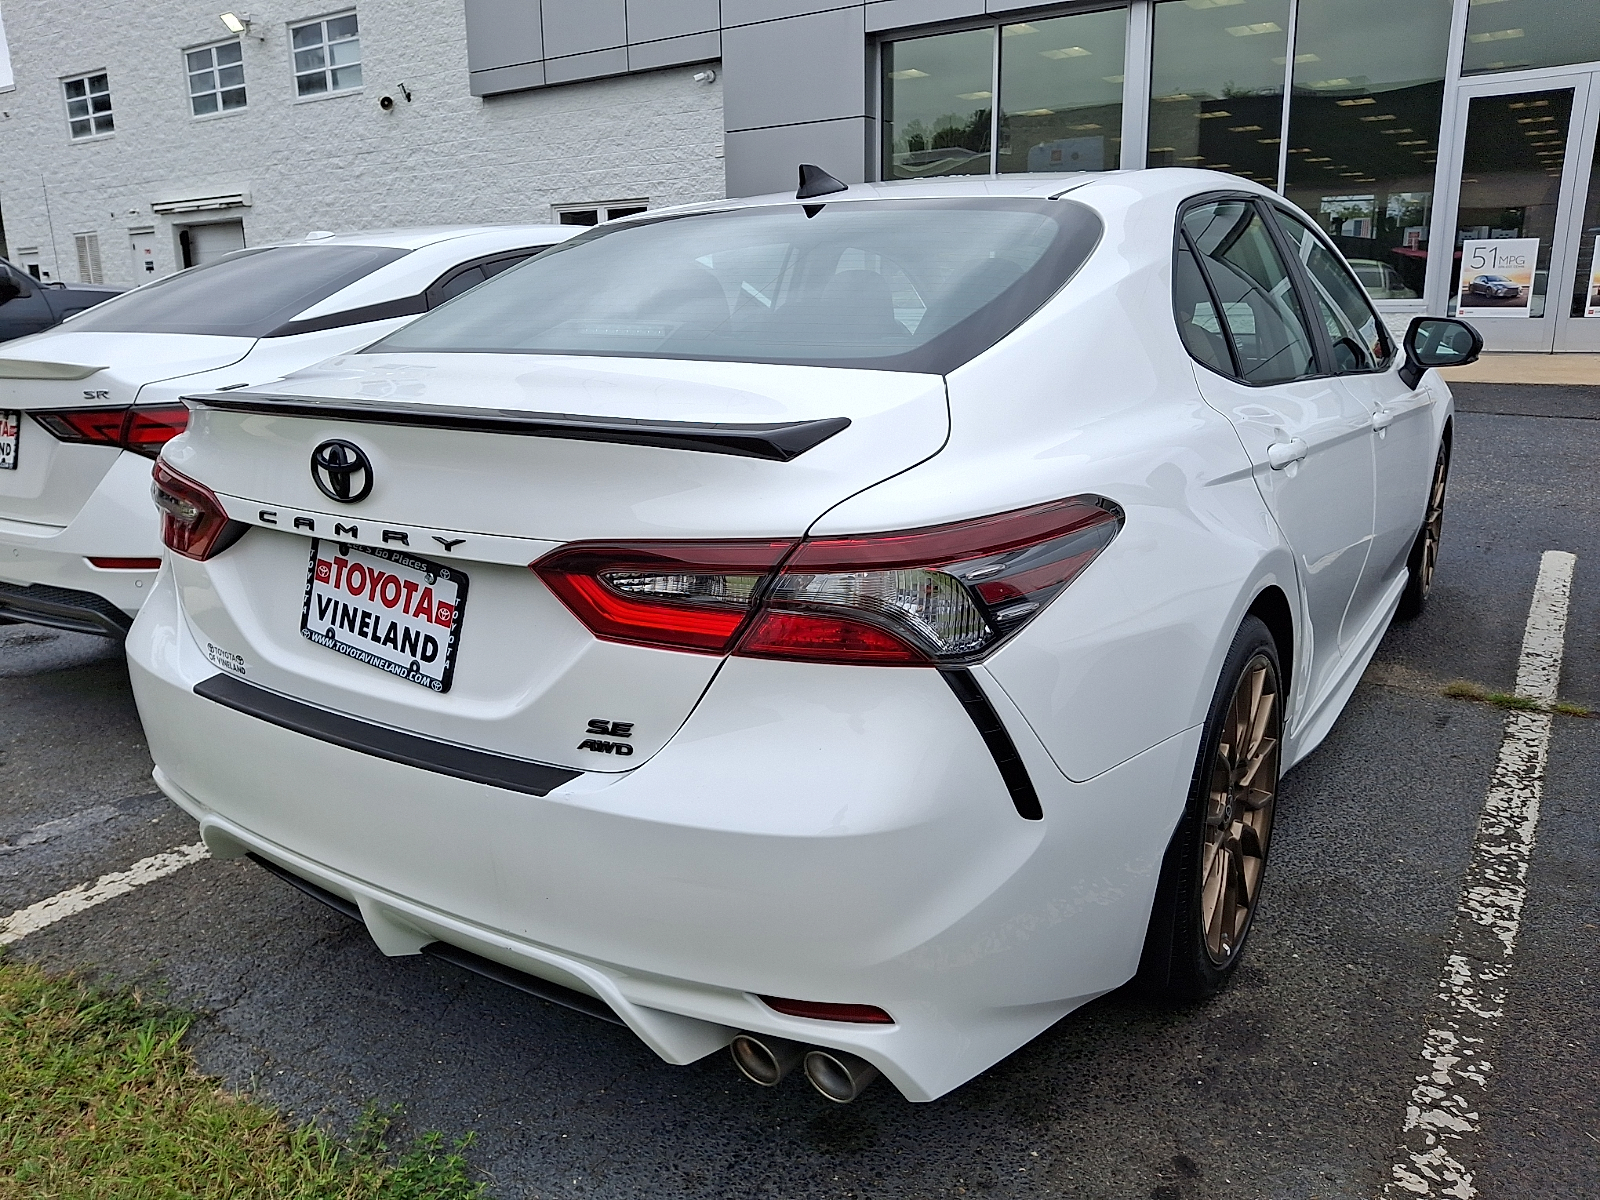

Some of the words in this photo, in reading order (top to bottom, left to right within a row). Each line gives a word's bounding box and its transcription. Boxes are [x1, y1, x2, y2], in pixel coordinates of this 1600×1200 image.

[1470, 246, 1498, 269] 51
[1499, 255, 1526, 265] MPG
[83, 390, 110, 400] SR
[258, 509, 467, 552] CAMRY
[375, 548, 389, 559] Go
[392, 552, 428, 571] Places
[333, 555, 434, 624] TOYOTA
[316, 592, 439, 664] VINELAND
[311, 633, 431, 688] WWW.TOYOTAVINELAND.COM
[585, 718, 635, 738] SE
[576, 738, 634, 756] AWD
